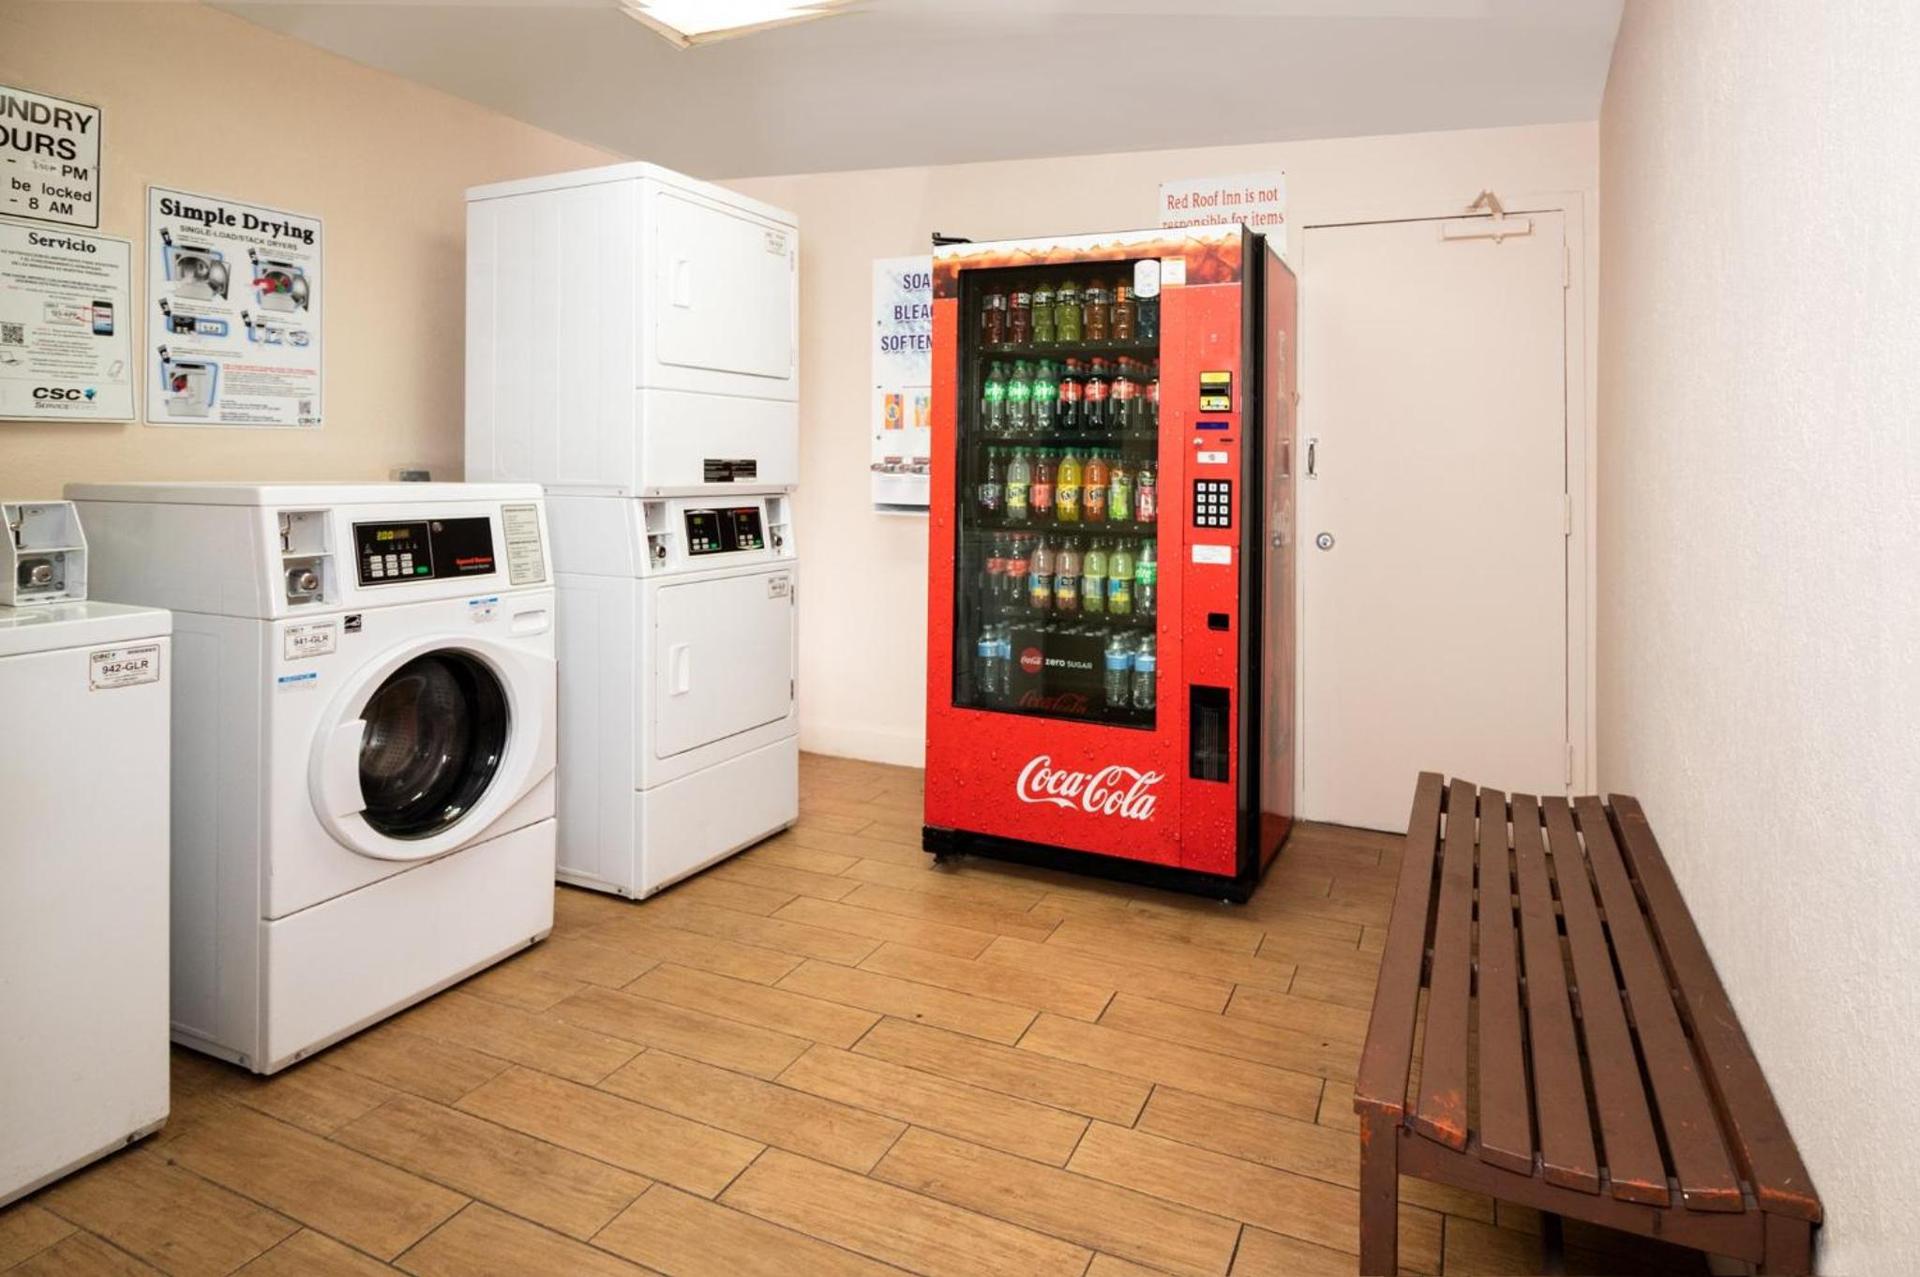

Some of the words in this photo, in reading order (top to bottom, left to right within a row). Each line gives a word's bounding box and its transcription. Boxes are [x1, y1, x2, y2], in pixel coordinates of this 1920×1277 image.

[62, 164, 88, 181] PM
[11, 176, 31, 192] be
[41, 182, 92, 202] locked
[28, 197, 39, 210] 8
[48, 201, 73, 215] AM
[1167, 194, 1188, 210] Red
[1192, 190, 1218, 208] Roof
[1222, 189, 1241, 206] Inn
[1245, 188, 1255, 203] is
[1258, 188, 1278, 202] not
[160, 198, 236, 227] Simple
[242, 213, 314, 245] Drying
[1231, 211, 1248, 225] for
[1252, 211, 1284, 226] items
[28, 232, 97, 253] Servicio
[267, 238, 298, 251] DRYERS
[903, 273, 930, 289] SOA
[894, 304, 933, 320] BLEA
[33, 387, 81, 401] CSC
[102, 660, 149, 675] 942-GLR
[1045, 658, 1066, 668] zero
[1066, 660, 1093, 670] SUGAR
[1016, 755, 1166, 820] Coca-Cola
